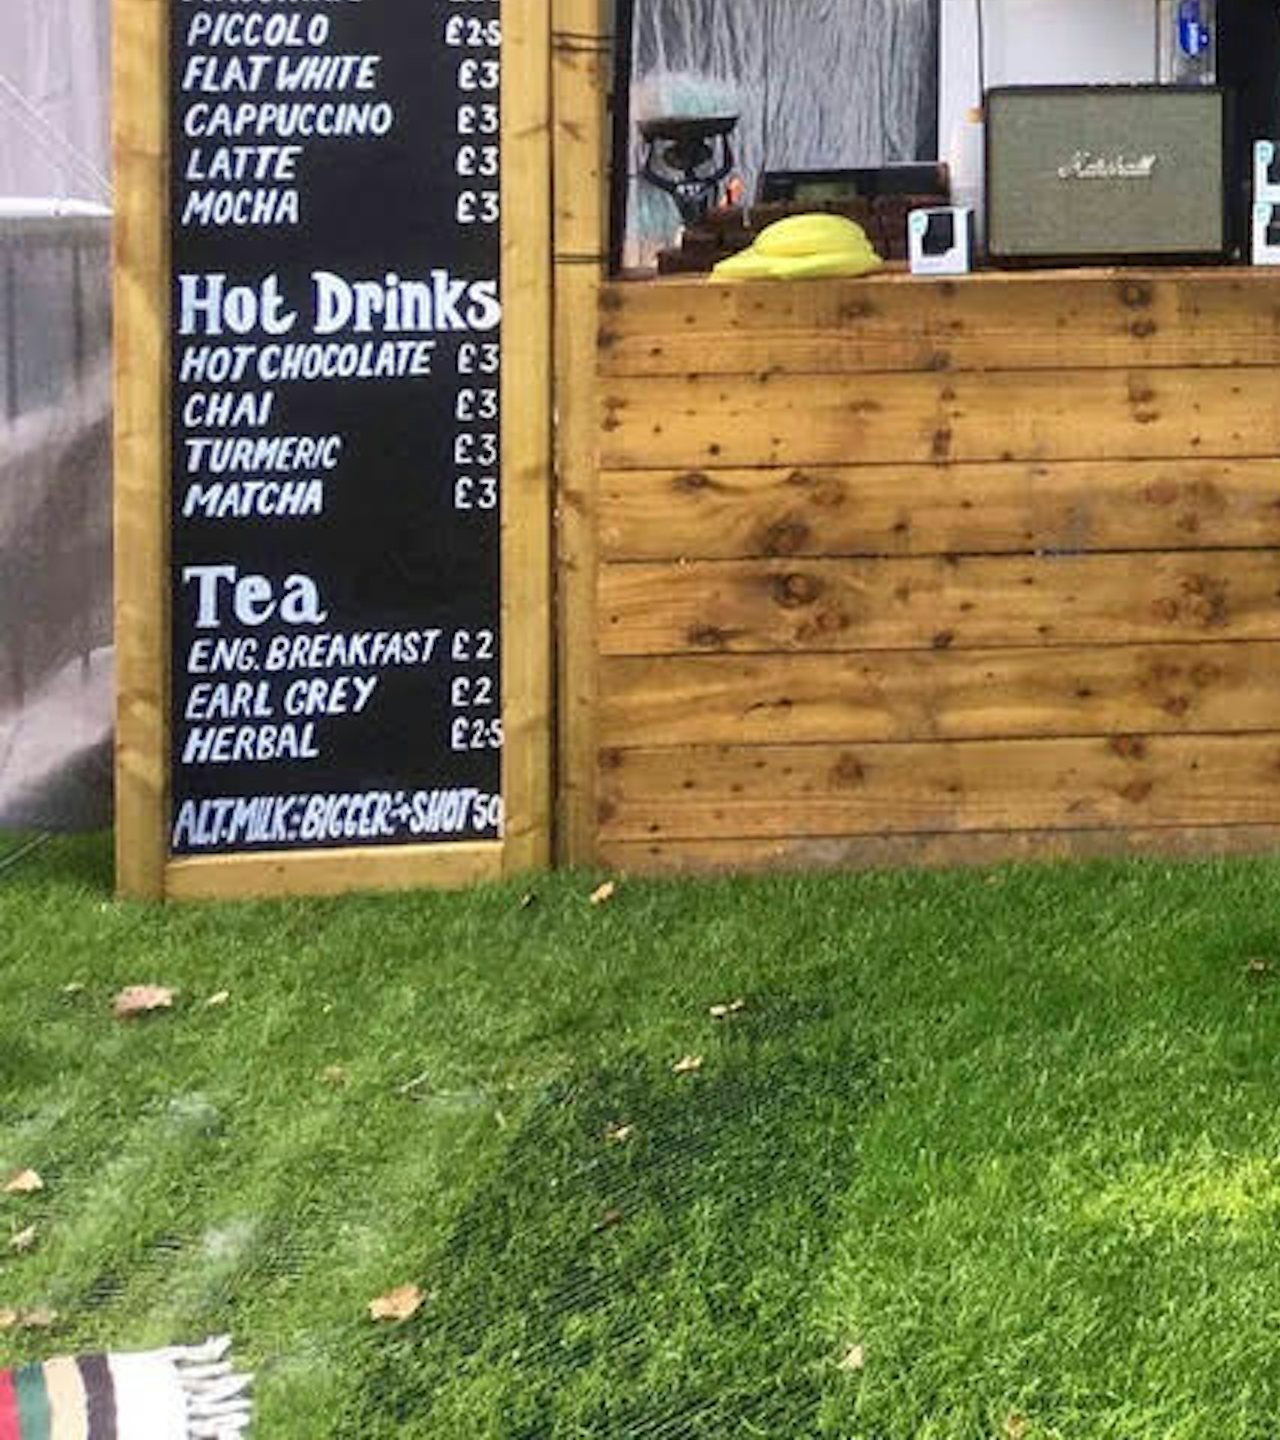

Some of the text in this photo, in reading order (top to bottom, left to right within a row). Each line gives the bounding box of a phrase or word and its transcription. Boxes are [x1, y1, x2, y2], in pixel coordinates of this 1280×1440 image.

[187, 12, 329, 47] PICCOLO
[182, 56, 500, 92] FLAT WHITE £3
[184, 103, 500, 137] CAPPUCCINO £3
[186, 145, 500, 181] LATTE £3
[182, 190, 500, 225] MOCHA £3
[178, 268, 502, 336] Hot Drinks
[179, 340, 500, 383] HOT CHOCOLATE £3
[183, 389, 499, 427] CHAI £3
[184, 433, 498, 473] TURMERIC £3
[182, 477, 498, 518] MATCHA £3
[182, 565, 328, 629] Tea
[188, 629, 494, 674] ENG. BREAKFAST £2
[185, 676, 493, 720] EARL GREY £2
[182, 722, 320, 764] HERBAL
